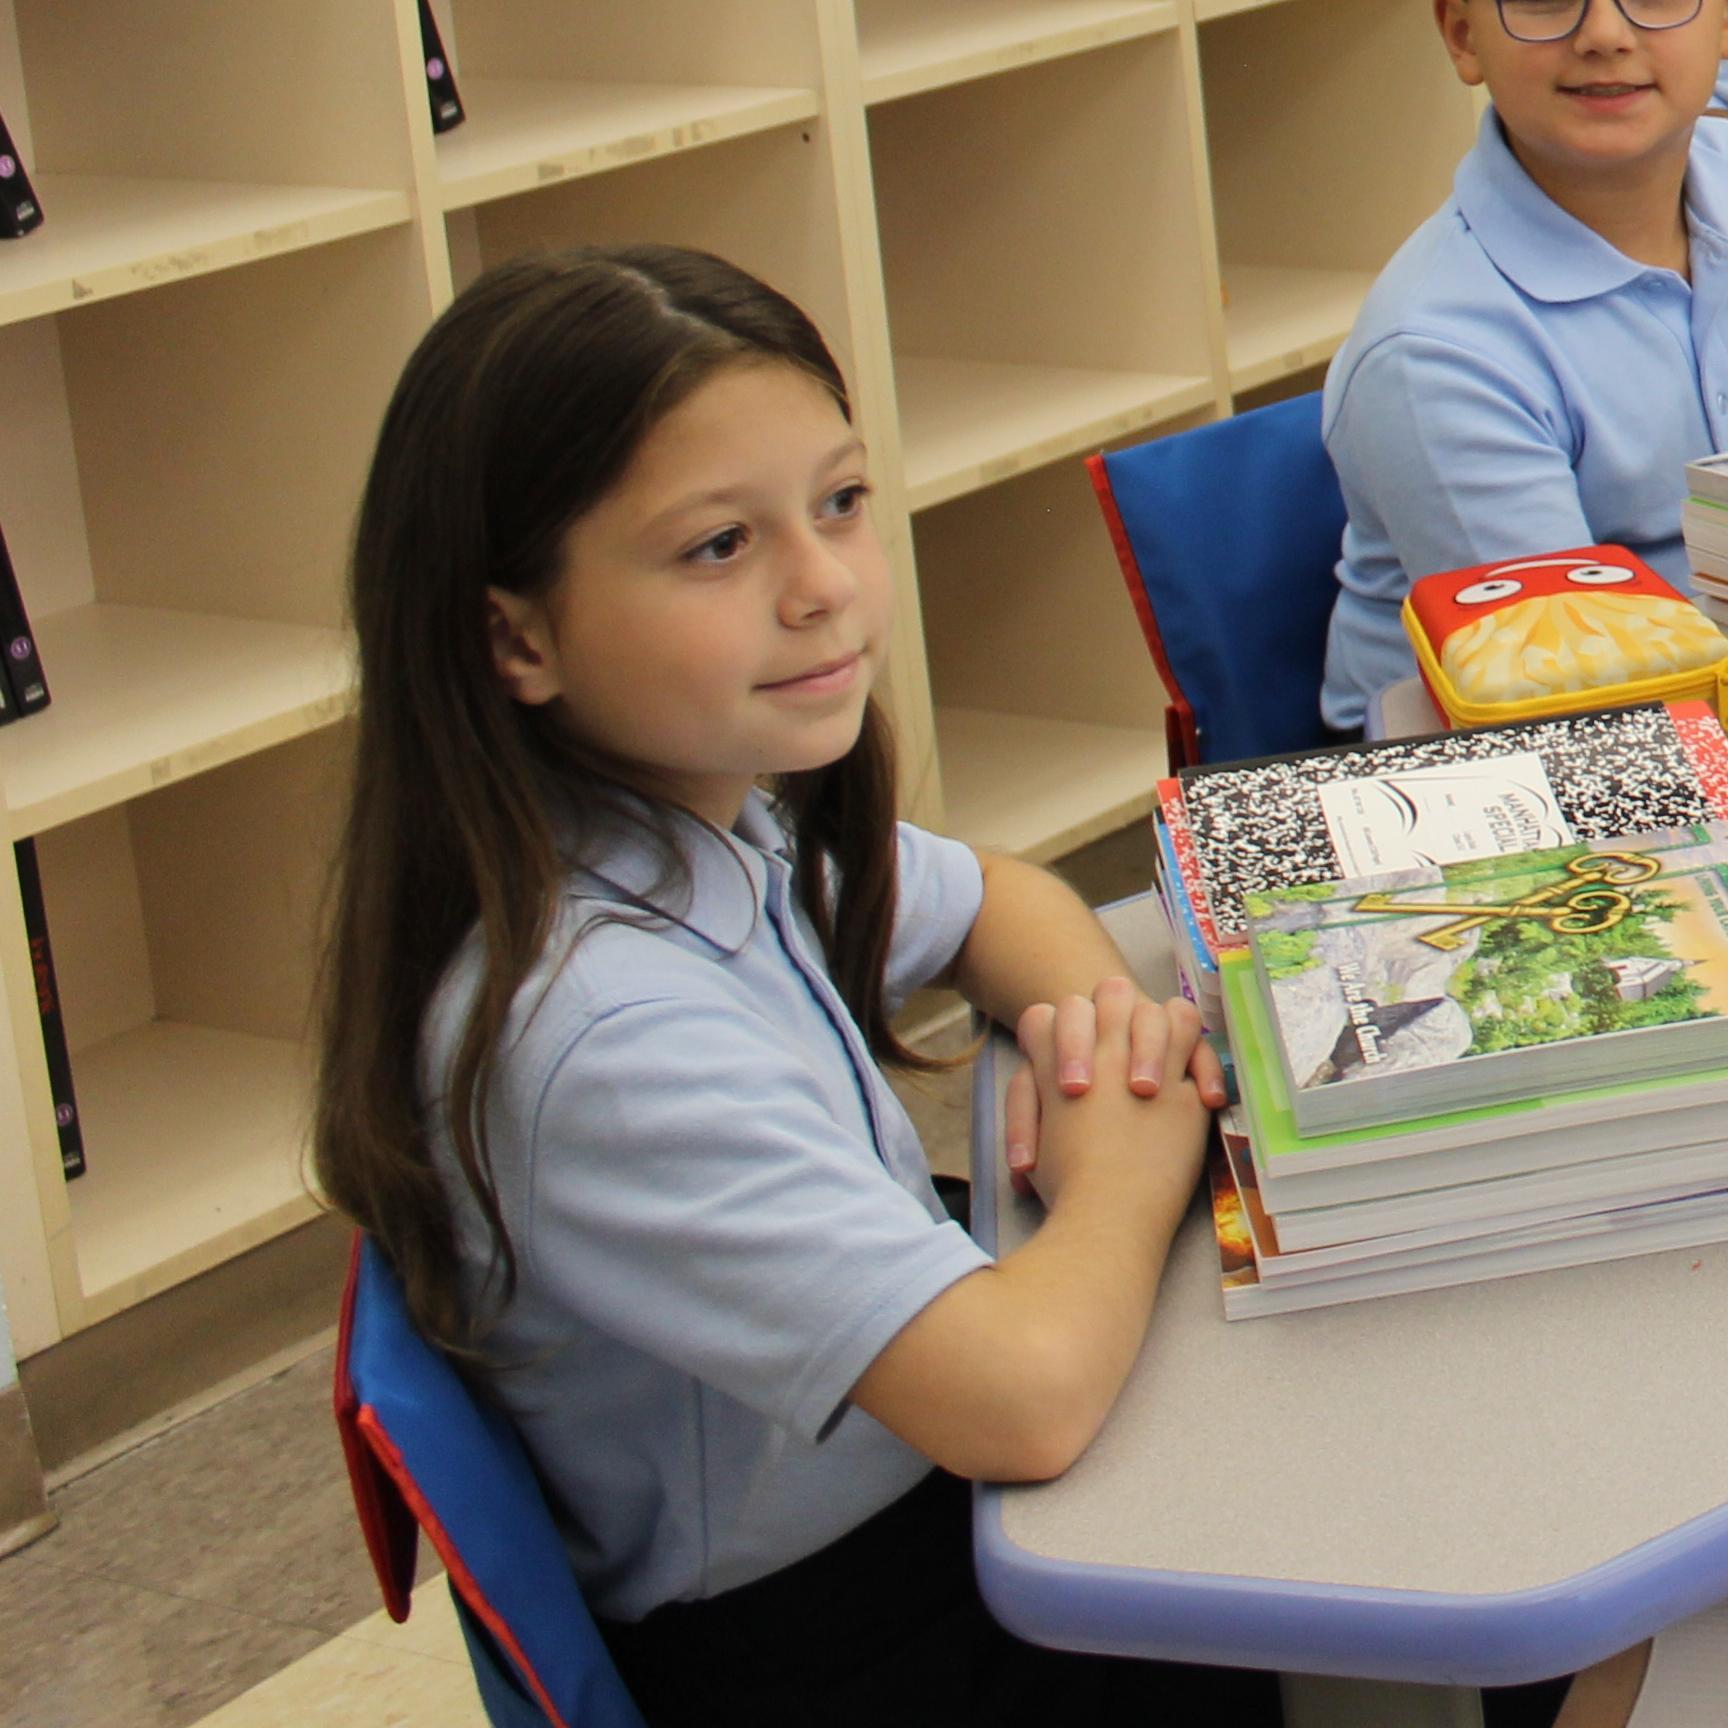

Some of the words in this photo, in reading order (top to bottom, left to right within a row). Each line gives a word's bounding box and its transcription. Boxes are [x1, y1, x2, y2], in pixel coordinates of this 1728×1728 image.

[1502, 792, 1542, 851] MANHATTA
[1338, 962, 1361, 982] We
[1340, 982, 1366, 1003] Are
[1348, 1002, 1375, 1026] the
[1355, 1024, 1388, 1065] Church
